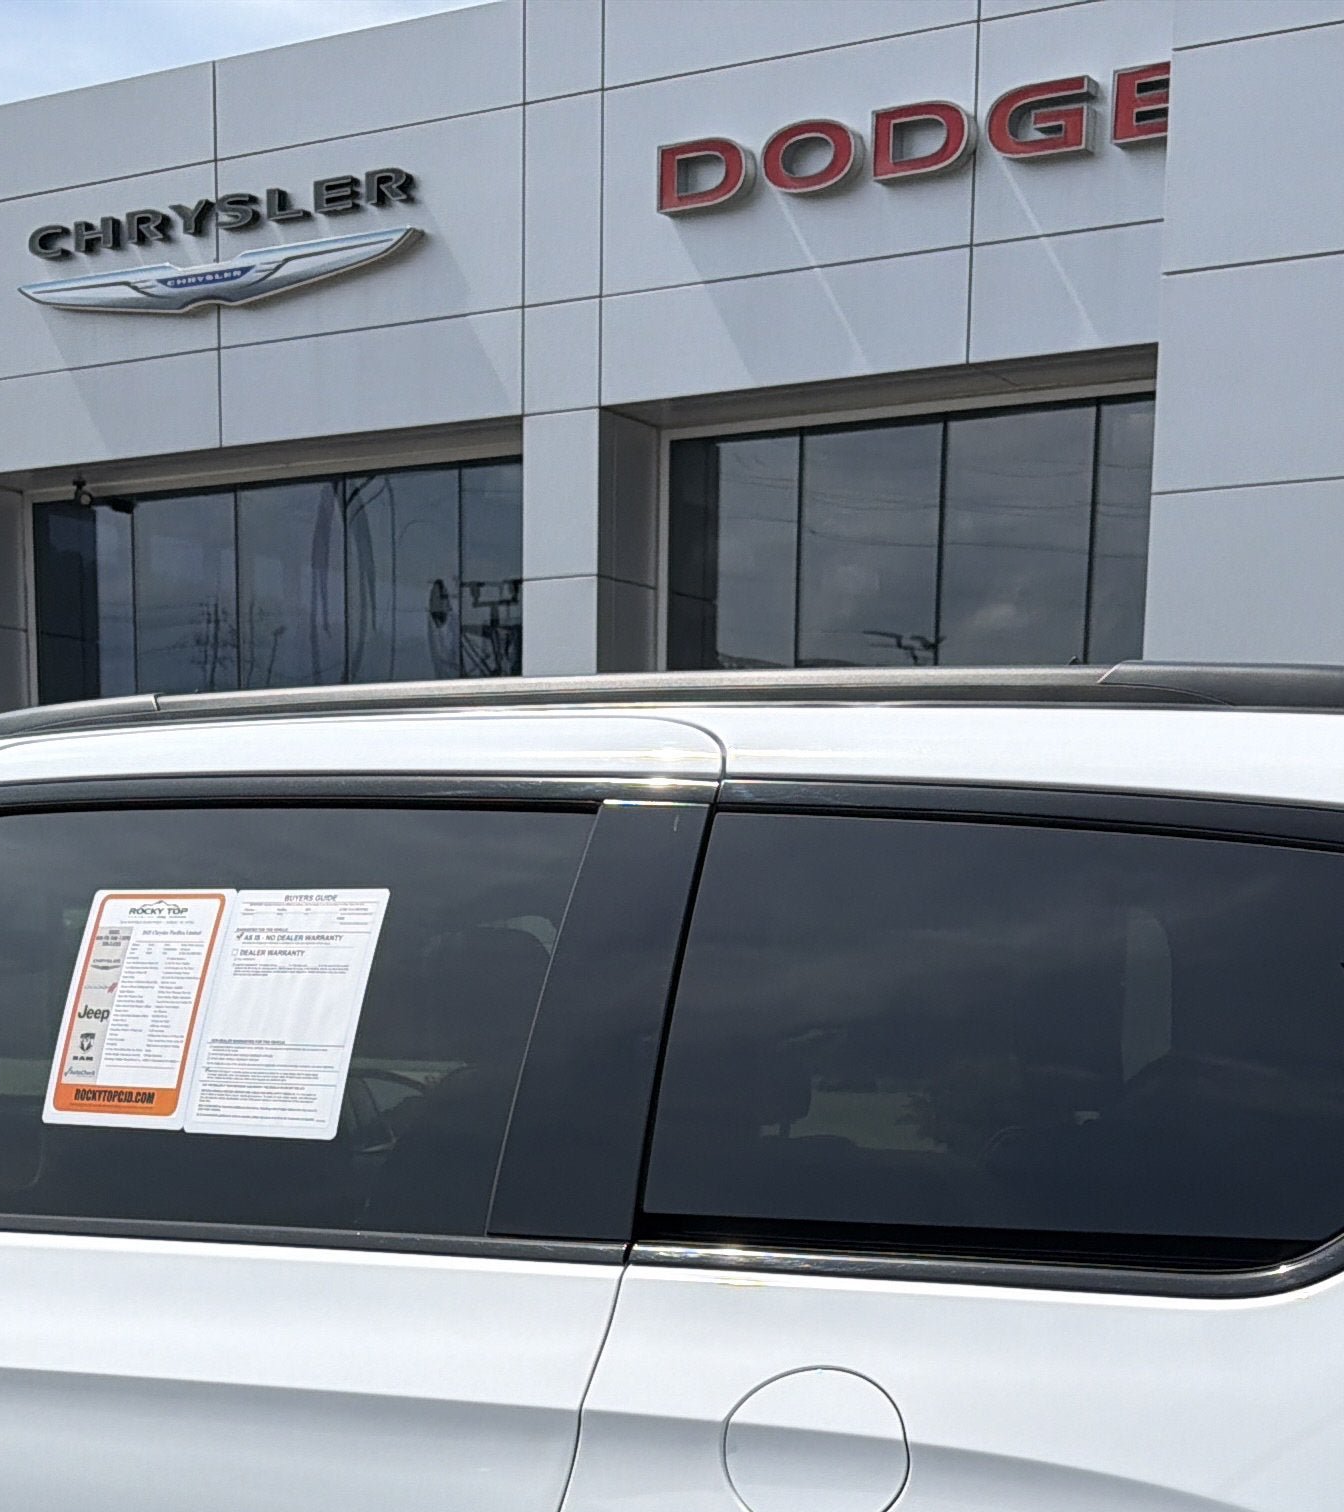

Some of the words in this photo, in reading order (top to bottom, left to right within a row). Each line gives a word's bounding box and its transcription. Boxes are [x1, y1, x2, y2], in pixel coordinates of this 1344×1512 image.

[657, 61, 1171, 214] DODGE
[28, 166, 414, 260] CHRYSLER
[166, 270, 242, 287] CHRYSLER
[128, 907, 165, 915] ROCKY
[167, 907, 189, 915] TOP
[77, 1004, 111, 1023] Jeep
